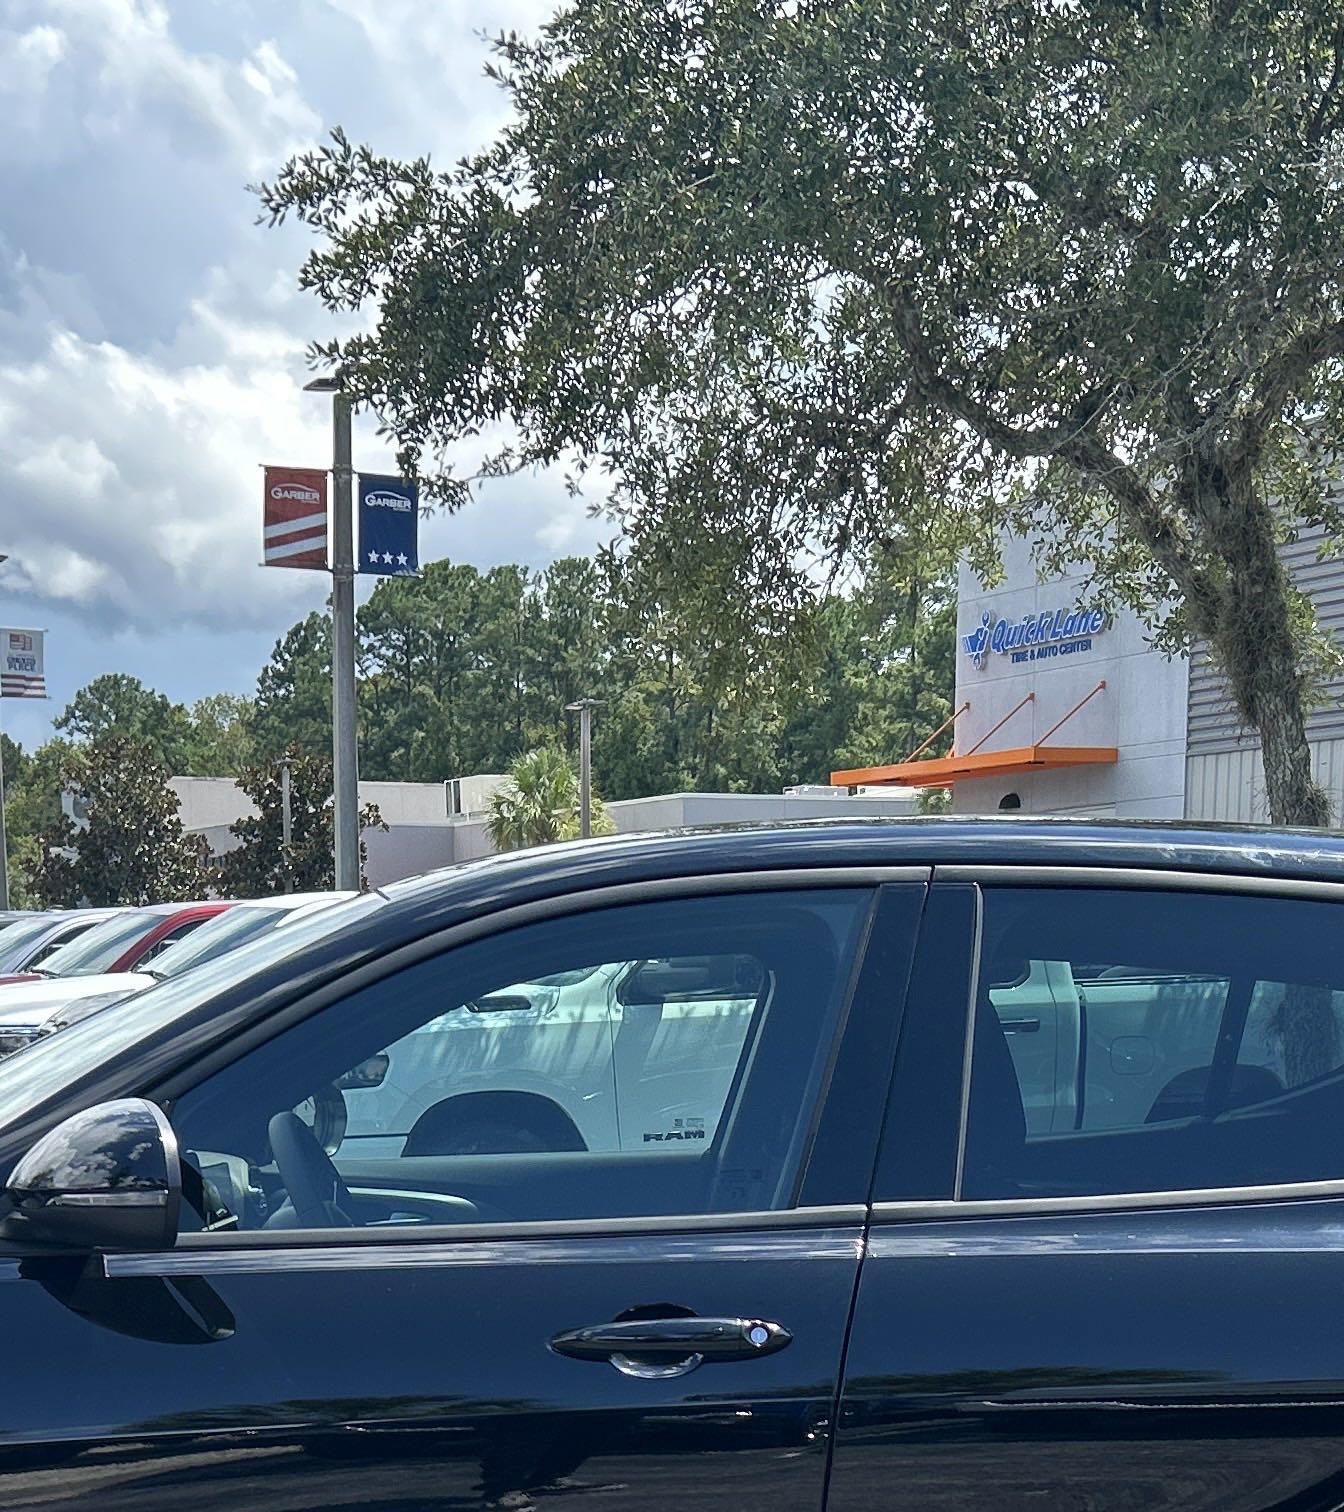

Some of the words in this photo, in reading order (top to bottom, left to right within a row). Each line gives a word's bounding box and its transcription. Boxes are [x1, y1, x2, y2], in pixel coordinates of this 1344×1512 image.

[270, 487, 320, 502] GARBER
[365, 494, 412, 510] GARBER
[991, 611, 1051, 654] Quick
[1049, 608, 1105, 640] Lane
[1010, 650, 1029, 663] TIRE
[1036, 644, 1058, 659] AUTO
[1058, 639, 1092, 655] CENTER
[643, 1130, 704, 1142] RAM
